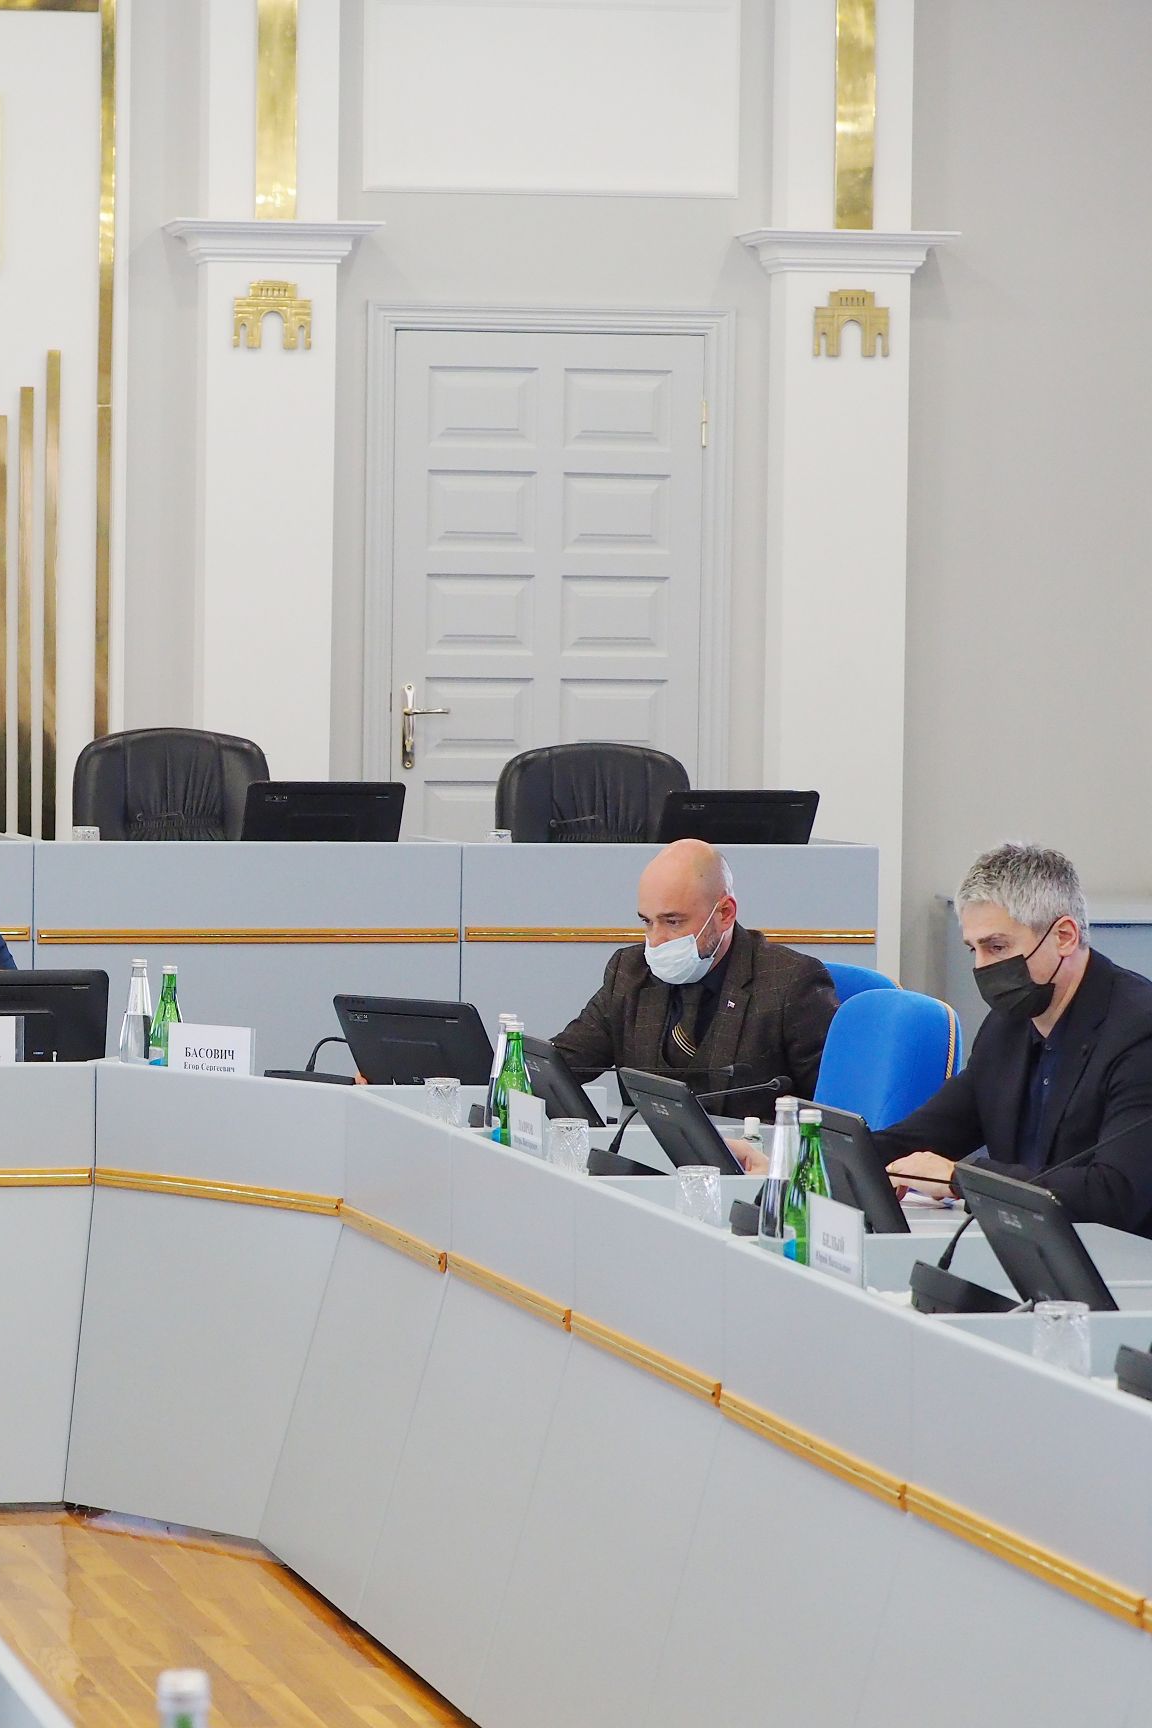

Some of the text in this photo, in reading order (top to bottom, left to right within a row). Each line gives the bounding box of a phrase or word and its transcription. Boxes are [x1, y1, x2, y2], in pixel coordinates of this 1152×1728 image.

[185, 1046, 235, 1060] БАСОВИЧ
[183, 1062, 235, 1073] Егор Сергеевич
[822, 1231, 845, 1256] БЕЛЫЙ
